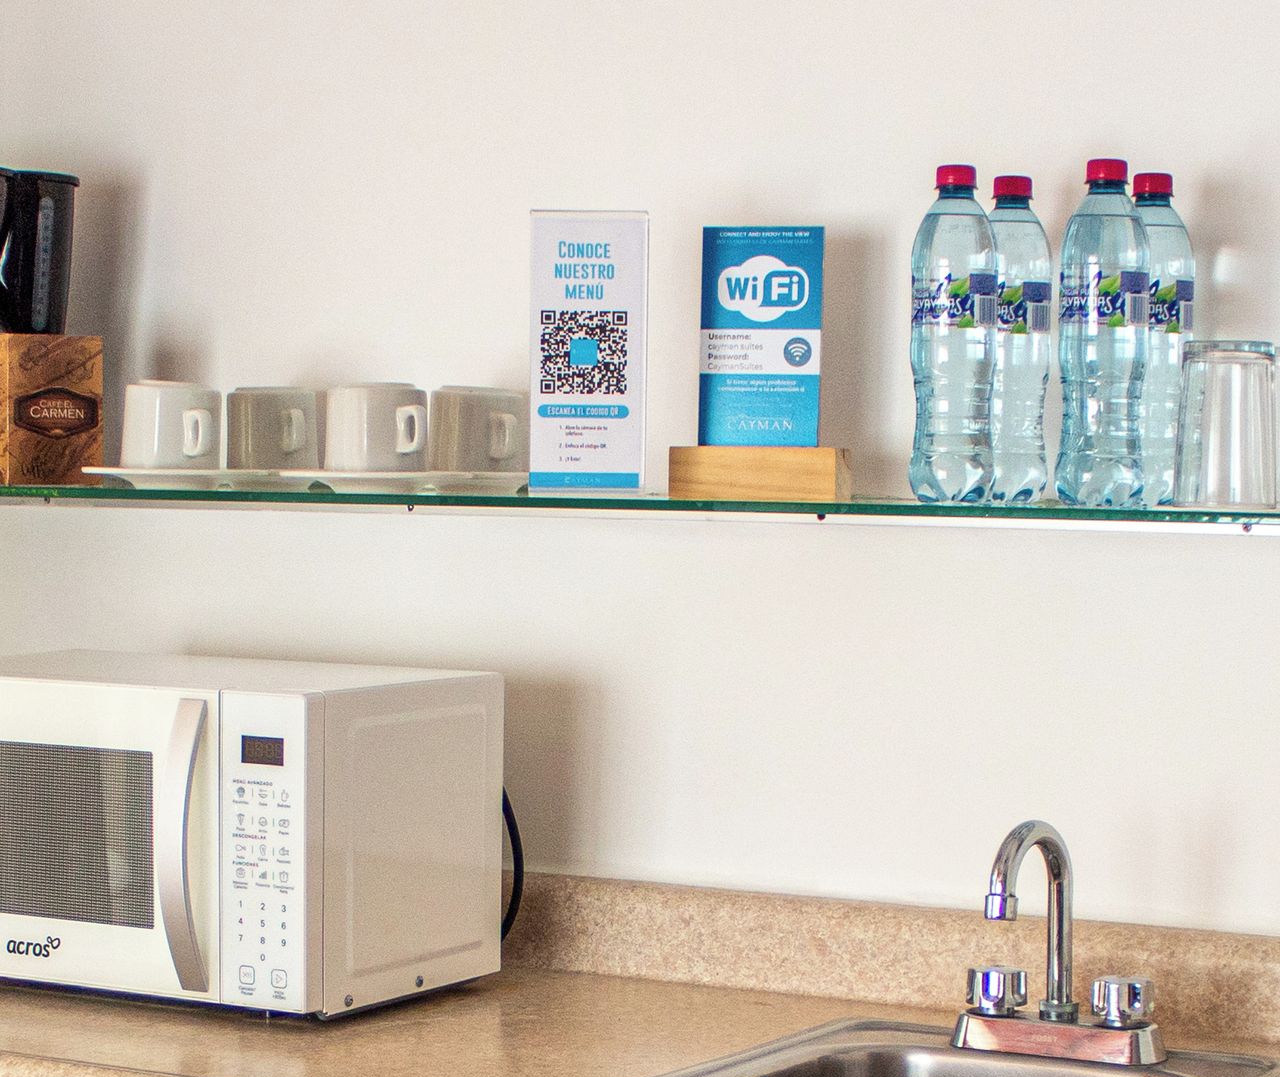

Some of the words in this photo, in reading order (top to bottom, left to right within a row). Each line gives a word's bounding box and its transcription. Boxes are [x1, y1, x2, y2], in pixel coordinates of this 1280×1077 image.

[558, 240, 611, 259] CONOCE
[554, 263, 615, 280] NUESTRO
[565, 281, 604, 300] MENÚ
[708, 333, 751, 341] Username:
[30, 406, 84, 419] CARMEN
[547, 406, 575, 415] ESCANEA
[727, 420, 793, 430] CAYMAN
[239, 900, 243, 908] 1
[260, 902, 266, 911] 2
[281, 904, 287, 913] 3
[260, 919, 266, 928] 5
[281, 921, 287, 930] 6
[238, 934, 244, 942] 7
[260, 936, 266, 945] 8
[281, 938, 287, 947] 9
[6, 939, 51, 958] acros
[260, 953, 266, 962] 0
